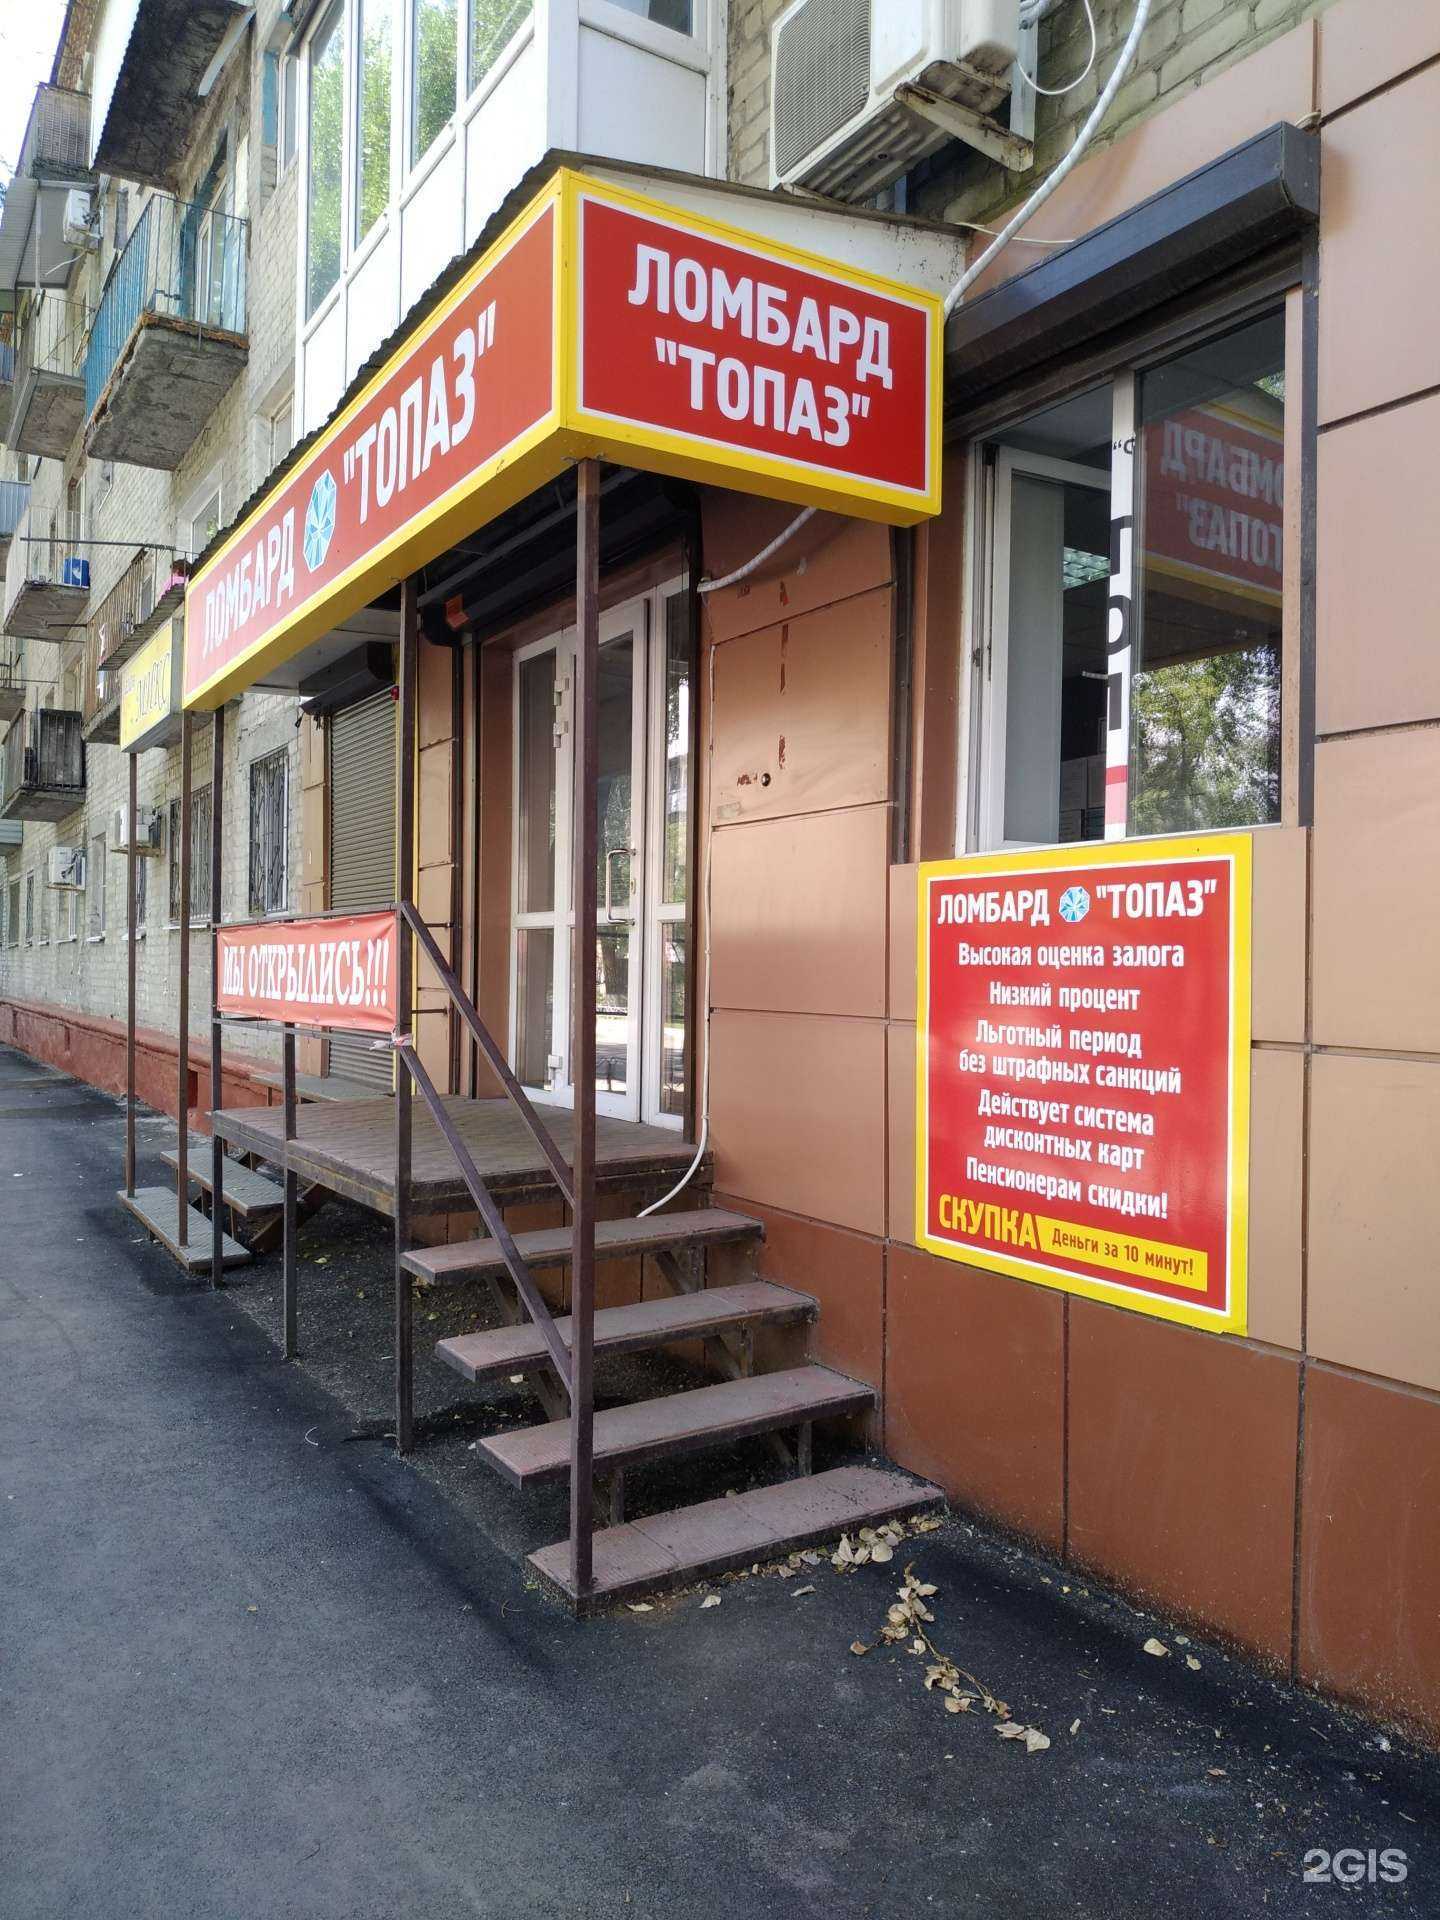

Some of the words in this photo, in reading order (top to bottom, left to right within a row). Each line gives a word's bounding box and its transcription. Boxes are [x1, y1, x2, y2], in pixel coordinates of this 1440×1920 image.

[628, 243, 893, 390] ЛОМБАРД
[655, 337, 871, 447] "ТОПАЗ"
[203, 506, 296, 658] ЛОМБАРД
[343, 301, 497, 525] "ТОПАЗ"
[938, 888, 1050, 926] ЛОМБАРД
[1096, 879, 1218, 919] "ТОПАЗ"
[223, 945, 245, 996] МЫ
[249, 938, 389, 1007] ОТКРЫЛИСЬ!!!
[958, 943, 1032, 967] Высокая
[1037, 945, 1105, 969] оценка
[1112, 943, 1185, 967] залога
[990, 981, 1052, 1007] Низкий
[1059, 986, 1140, 1012] процент
[975, 1019, 1062, 1048] Льготный
[1069, 1028, 1142, 1058] период
[959, 1049, 986, 1074] без
[992, 1053, 1090, 1085] штрафных
[1095, 1065, 1181, 1096] санкций
[978, 1089, 1070, 1125] Действует
[1074, 1106, 1154, 1136] система
[984, 1124, 1092, 1161] дисконтных
[1098, 1137, 1145, 1171] карт
[966, 1156, 1082, 1202] Пенсионерам
[1088, 1185, 1168, 1219] скидки!
[939, 1194, 1038, 1250] СКУПКА
[1052, 1228, 1100, 1254] Деньги
[1104, 1239, 1119, 1259] за
[1124, 1243, 1139, 1263] 10
[1145, 1250, 1194, 1276] минут!
